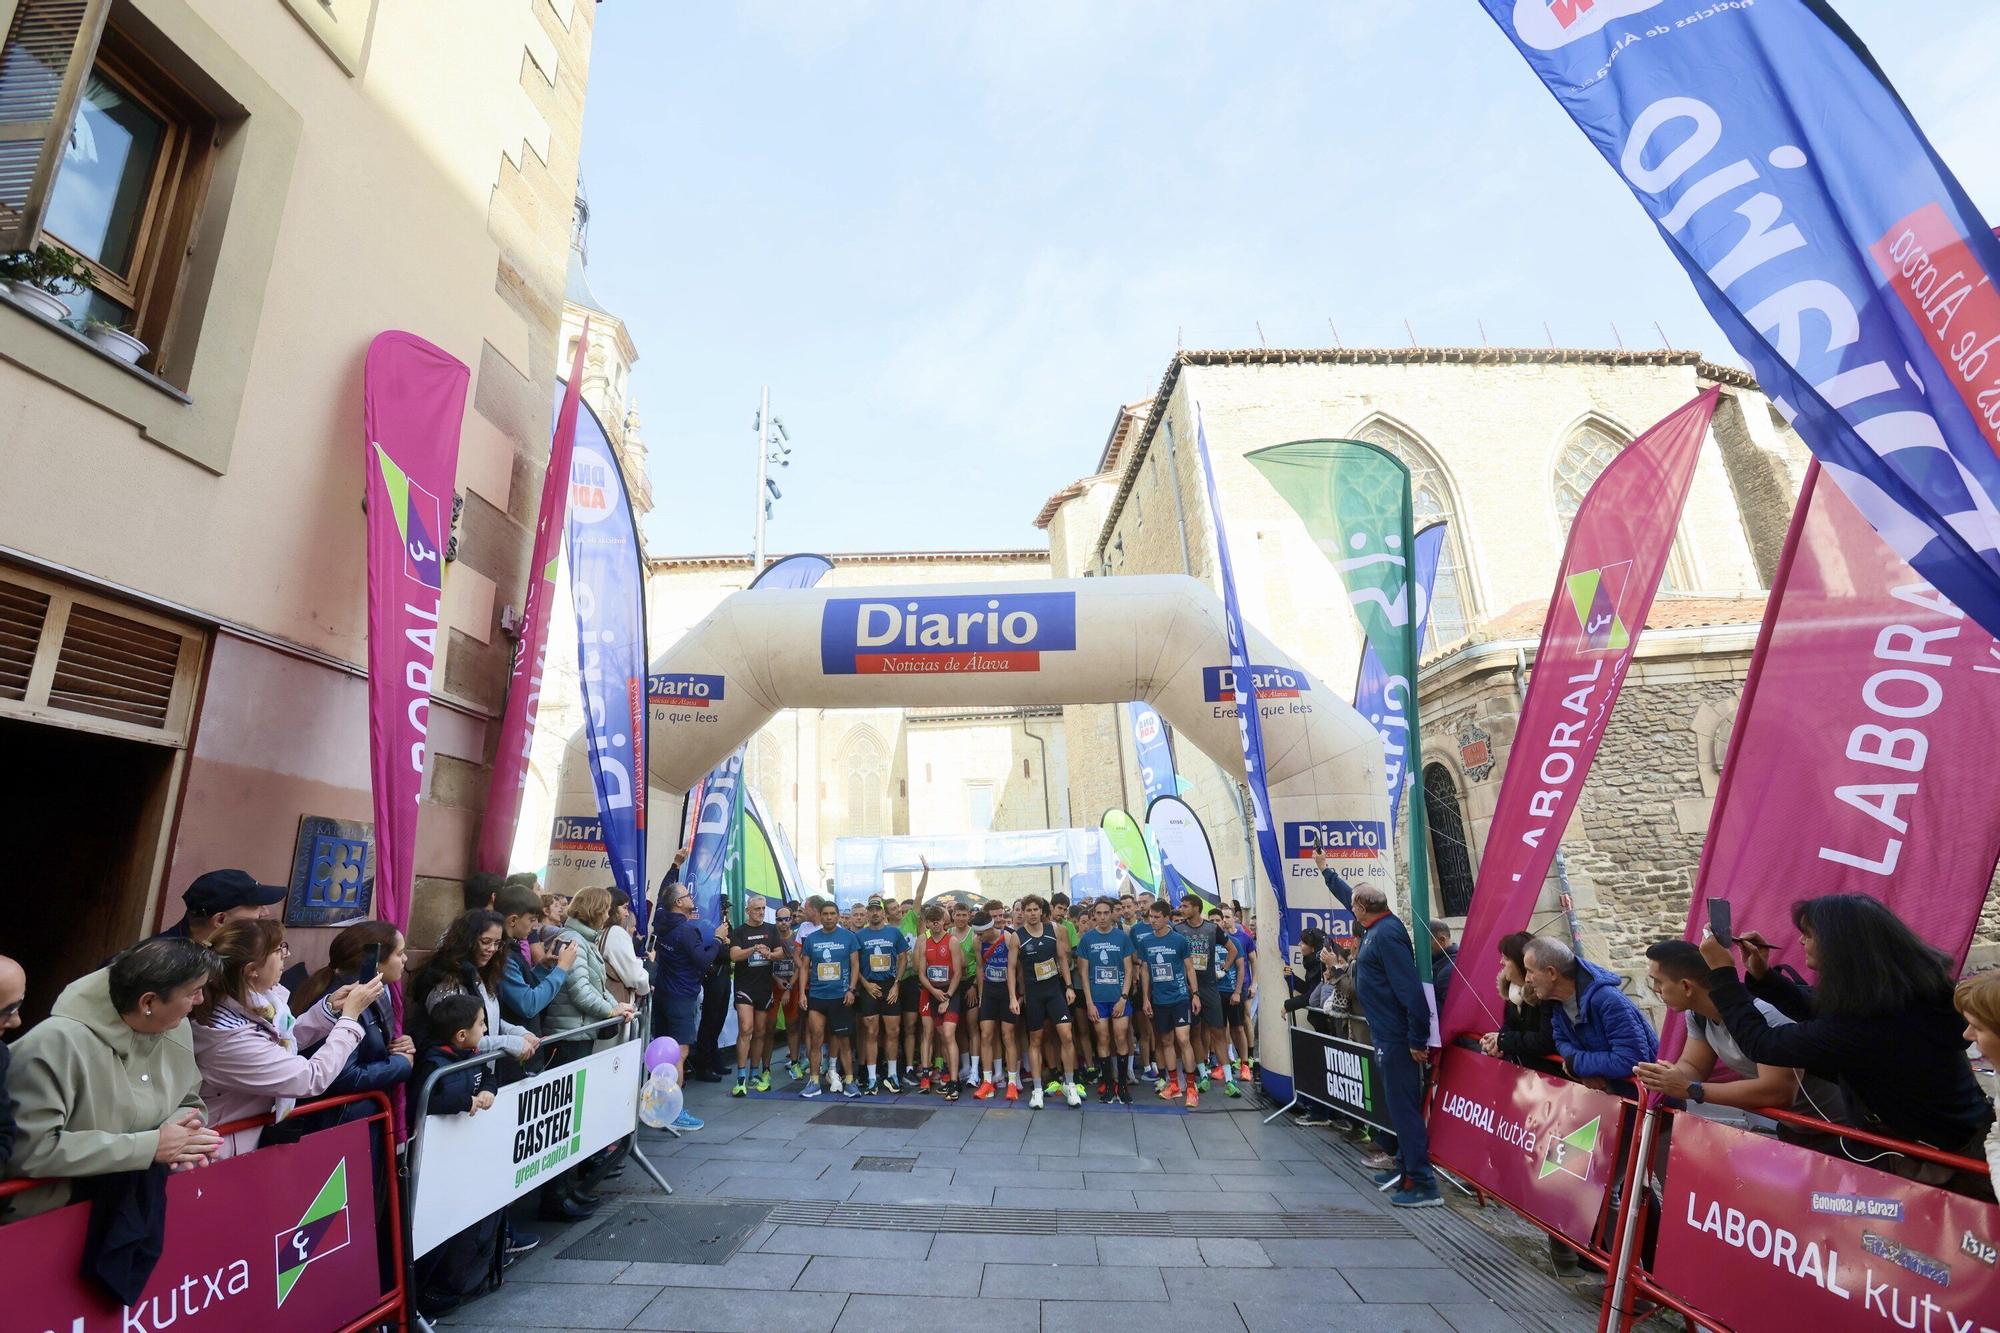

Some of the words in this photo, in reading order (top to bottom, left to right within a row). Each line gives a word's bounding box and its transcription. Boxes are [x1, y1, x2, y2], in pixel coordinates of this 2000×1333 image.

[857, 599, 1038, 647] Diario
[882, 657, 940, 672] Noticias
[944, 657, 960, 671] de
[964, 651, 1009, 671] Álava
[1218, 668, 1296, 691] Dario
[655, 709, 665, 721] lo
[670, 711, 692, 725] que
[695, 711, 719, 723] lees
[1260, 704, 1285, 719] que
[1289, 702, 1313, 714] lees
[554, 819, 604, 841] Diari
[1298, 824, 1378, 847] Diario
[562, 854, 573, 866] lo
[575, 857, 597, 871] que
[1291, 864, 1319, 877] Eres
[1341, 866, 1365, 880] que
[1323, 1045, 1362, 1081] VITORIA
[517, 1073, 574, 1127] VITORIA
[1326, 1070, 1365, 1109] GASTEIZ
[512, 1106, 572, 1164] GASTEIZ
[1441, 1090, 1494, 1135] LABORAL
[1495, 1119, 1537, 1153] kutxa
[514, 1157, 540, 1189] green
[541, 1140, 569, 1174] capital
[1687, 1191, 1850, 1300] LABORAL
[1961, 1231, 1997, 1264] 1312
